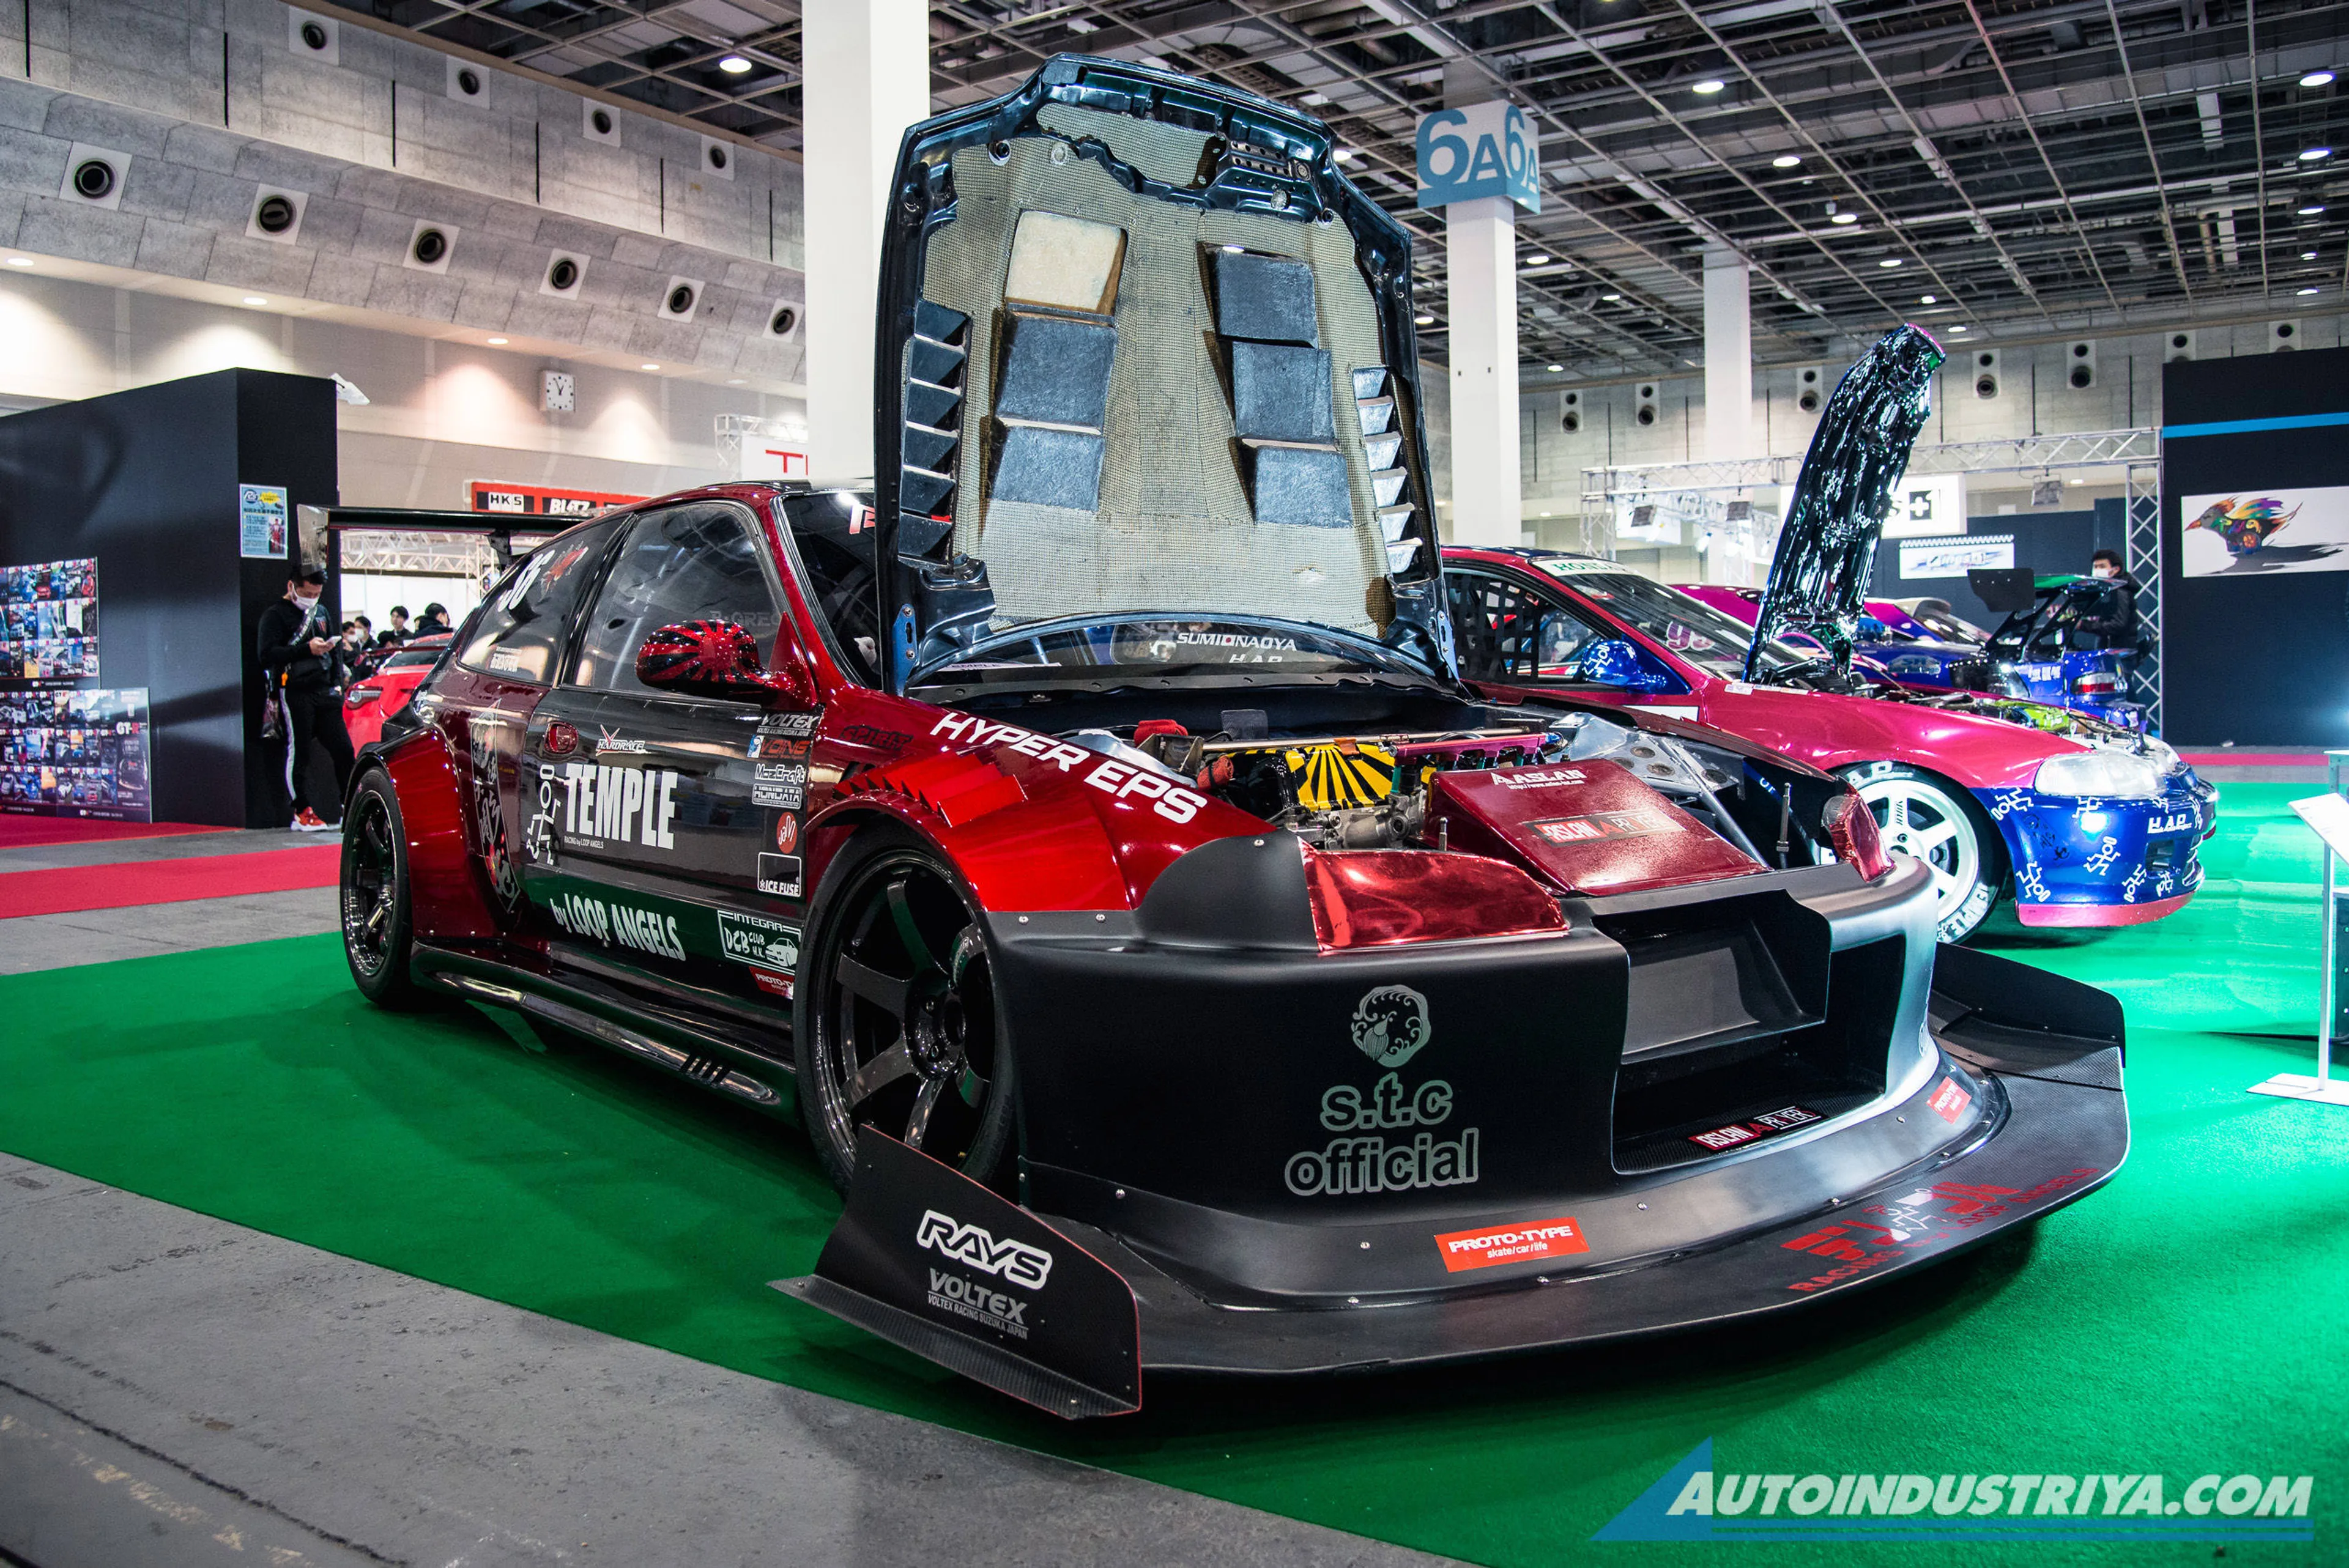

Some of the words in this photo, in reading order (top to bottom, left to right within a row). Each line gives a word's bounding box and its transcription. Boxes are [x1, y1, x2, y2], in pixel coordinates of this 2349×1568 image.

[1416, 109, 1507, 187] 6A
[1505, 105, 1538, 194] 6A
[490, 494, 522, 505] HKS
[762, 714, 820, 728] VOLTEX
[930, 712, 1091, 772] HYPER
[1084, 758, 1208, 824] EPS
[566, 763, 678, 850] TEMPLE
[581, 838, 590, 848] LOOP
[590, 840, 604, 849] ANGELS
[766, 880, 777, 892] ICE
[779, 882, 800, 895] FUSE
[550, 898, 572, 933] by
[564, 893, 610, 941] LOOP
[610, 904, 686, 961] ANGELS
[734, 912, 783, 932] INTEGRA
[1320, 1071, 1453, 1131] s.t.c
[1285, 1128, 1479, 1196] official
[1696, 1126, 1754, 1148] ASLAN
[916, 1210, 1052, 1290] RAYS
[1448, 1225, 1573, 1254] PROTO-TYPE
[1486, 1240, 1548, 1259] skate/car/life
[1787, 1250, 1905, 1292] RACING
[1940, 1204, 2011, 1230] LOOP
[2007, 1167, 2100, 1204] ANGELS
[928, 1294, 953, 1312] VOLTEX
[954, 1303, 979, 1322] RACING
[979, 1314, 1006, 1331] SUZUKA
[1006, 1323, 1028, 1340] JAPAN
[930, 1267, 1028, 1325] VOLTEX
